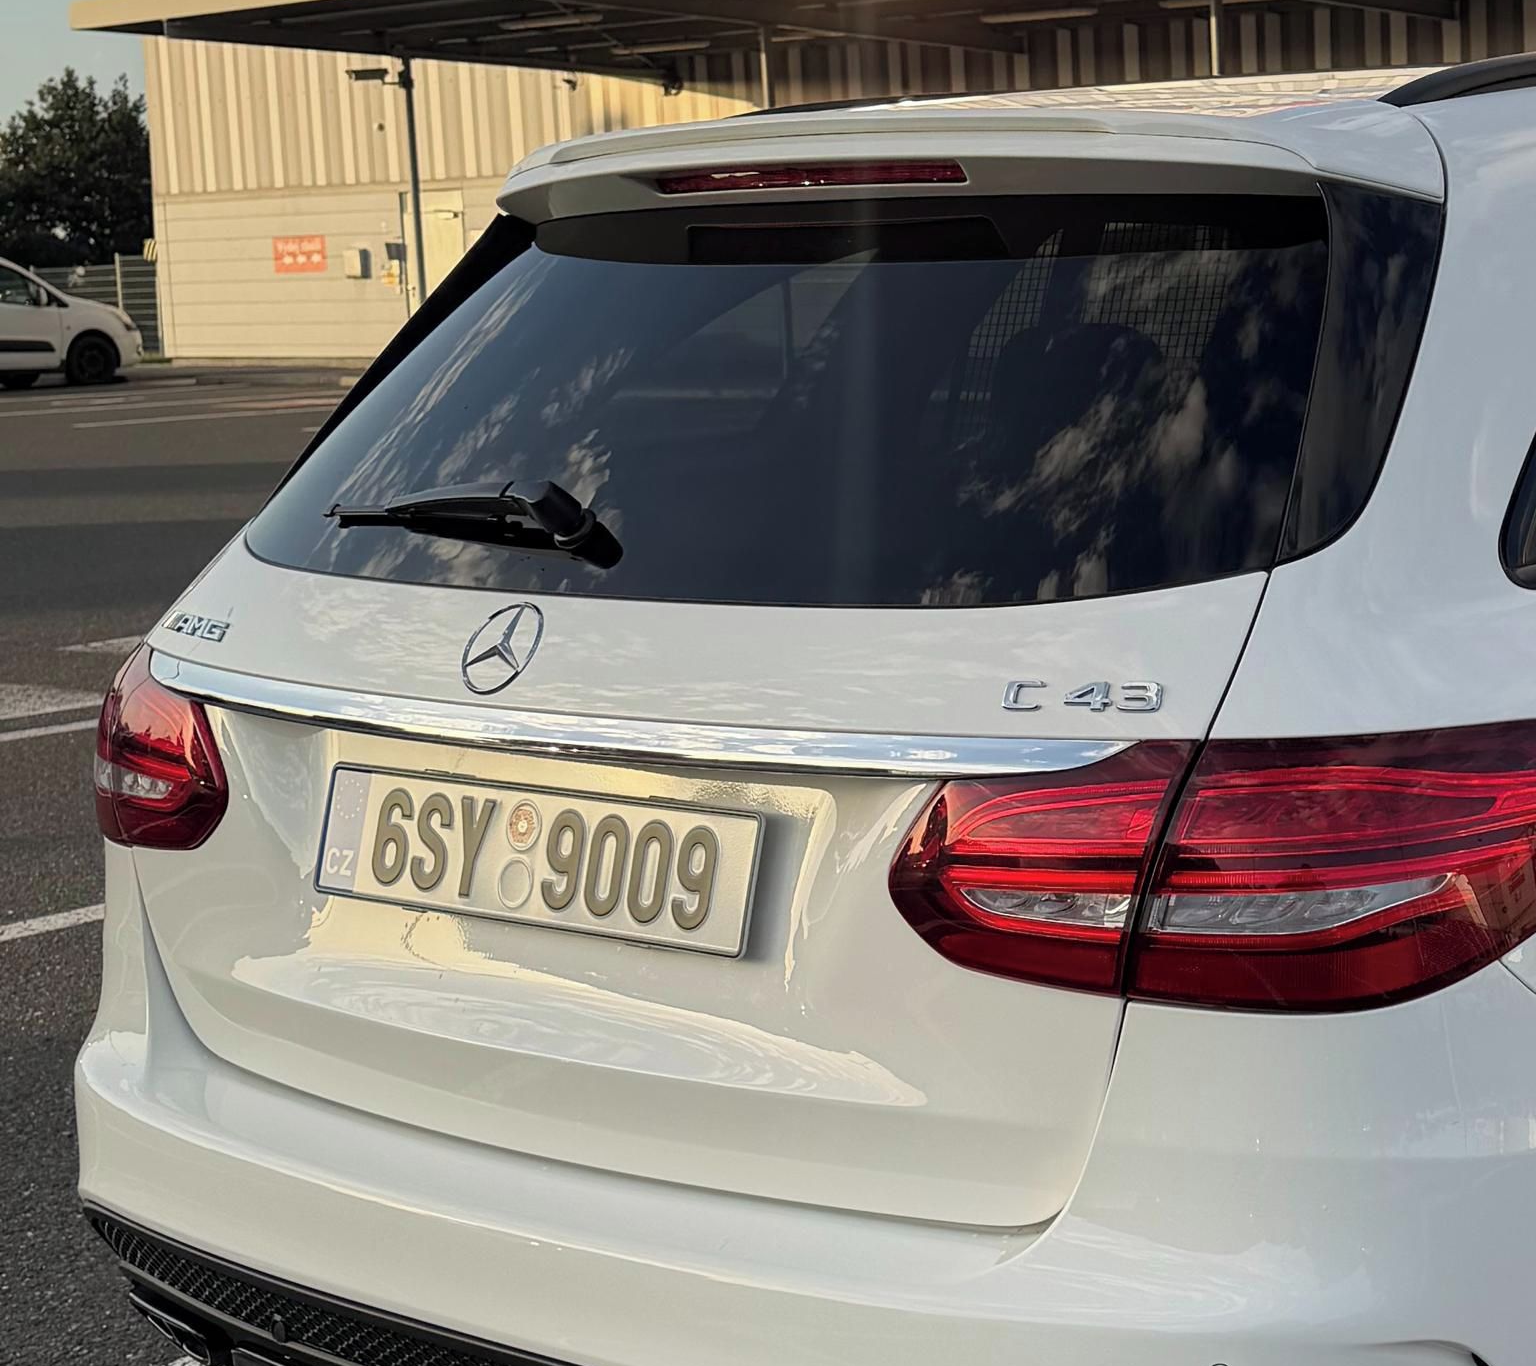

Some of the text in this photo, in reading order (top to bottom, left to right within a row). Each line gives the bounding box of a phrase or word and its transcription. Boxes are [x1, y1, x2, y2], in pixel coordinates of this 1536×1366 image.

[174, 612, 231, 643] AMG
[1001, 680, 1163, 713] C 43
[325, 845, 355, 877] CZ
[372, 787, 722, 931] 6SY 9009
